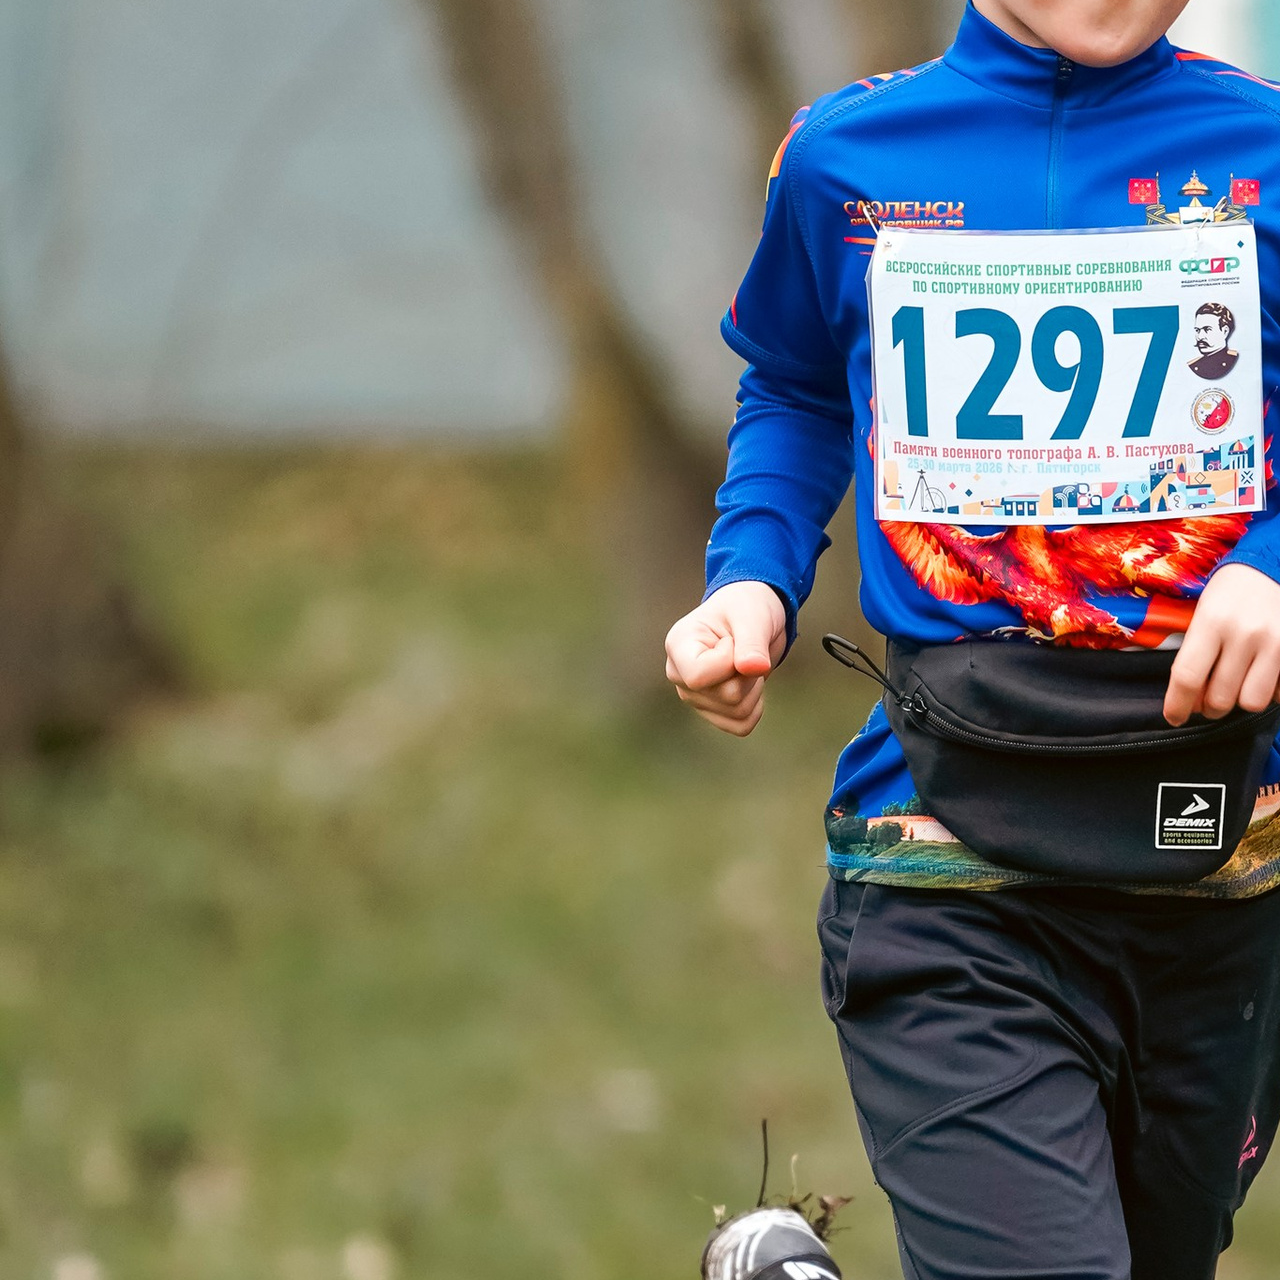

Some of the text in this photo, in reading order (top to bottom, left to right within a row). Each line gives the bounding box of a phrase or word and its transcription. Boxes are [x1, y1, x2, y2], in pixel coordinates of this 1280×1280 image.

[886, 259, 1172, 276] ВСЕРОССИЙСКИЕ СПОРТИВНЫЕ СОРЕВНОВАНИЯ
[913, 279, 1143, 294] ПО СПОРТИВНОМУ ОРИЕНТИРОВАНИЮ
[891, 305, 1180, 441] 1297
[893, 441, 1194, 462] Памяти военного топографа А. В. Пастухова
[907, 458, 935, 470] 25-30
[938, 461, 971, 474] марта
[976, 462, 1003, 474] 2026
[1037, 463, 1101, 475] Пятигорск
[1163, 817, 1216, 827] DEMIX
